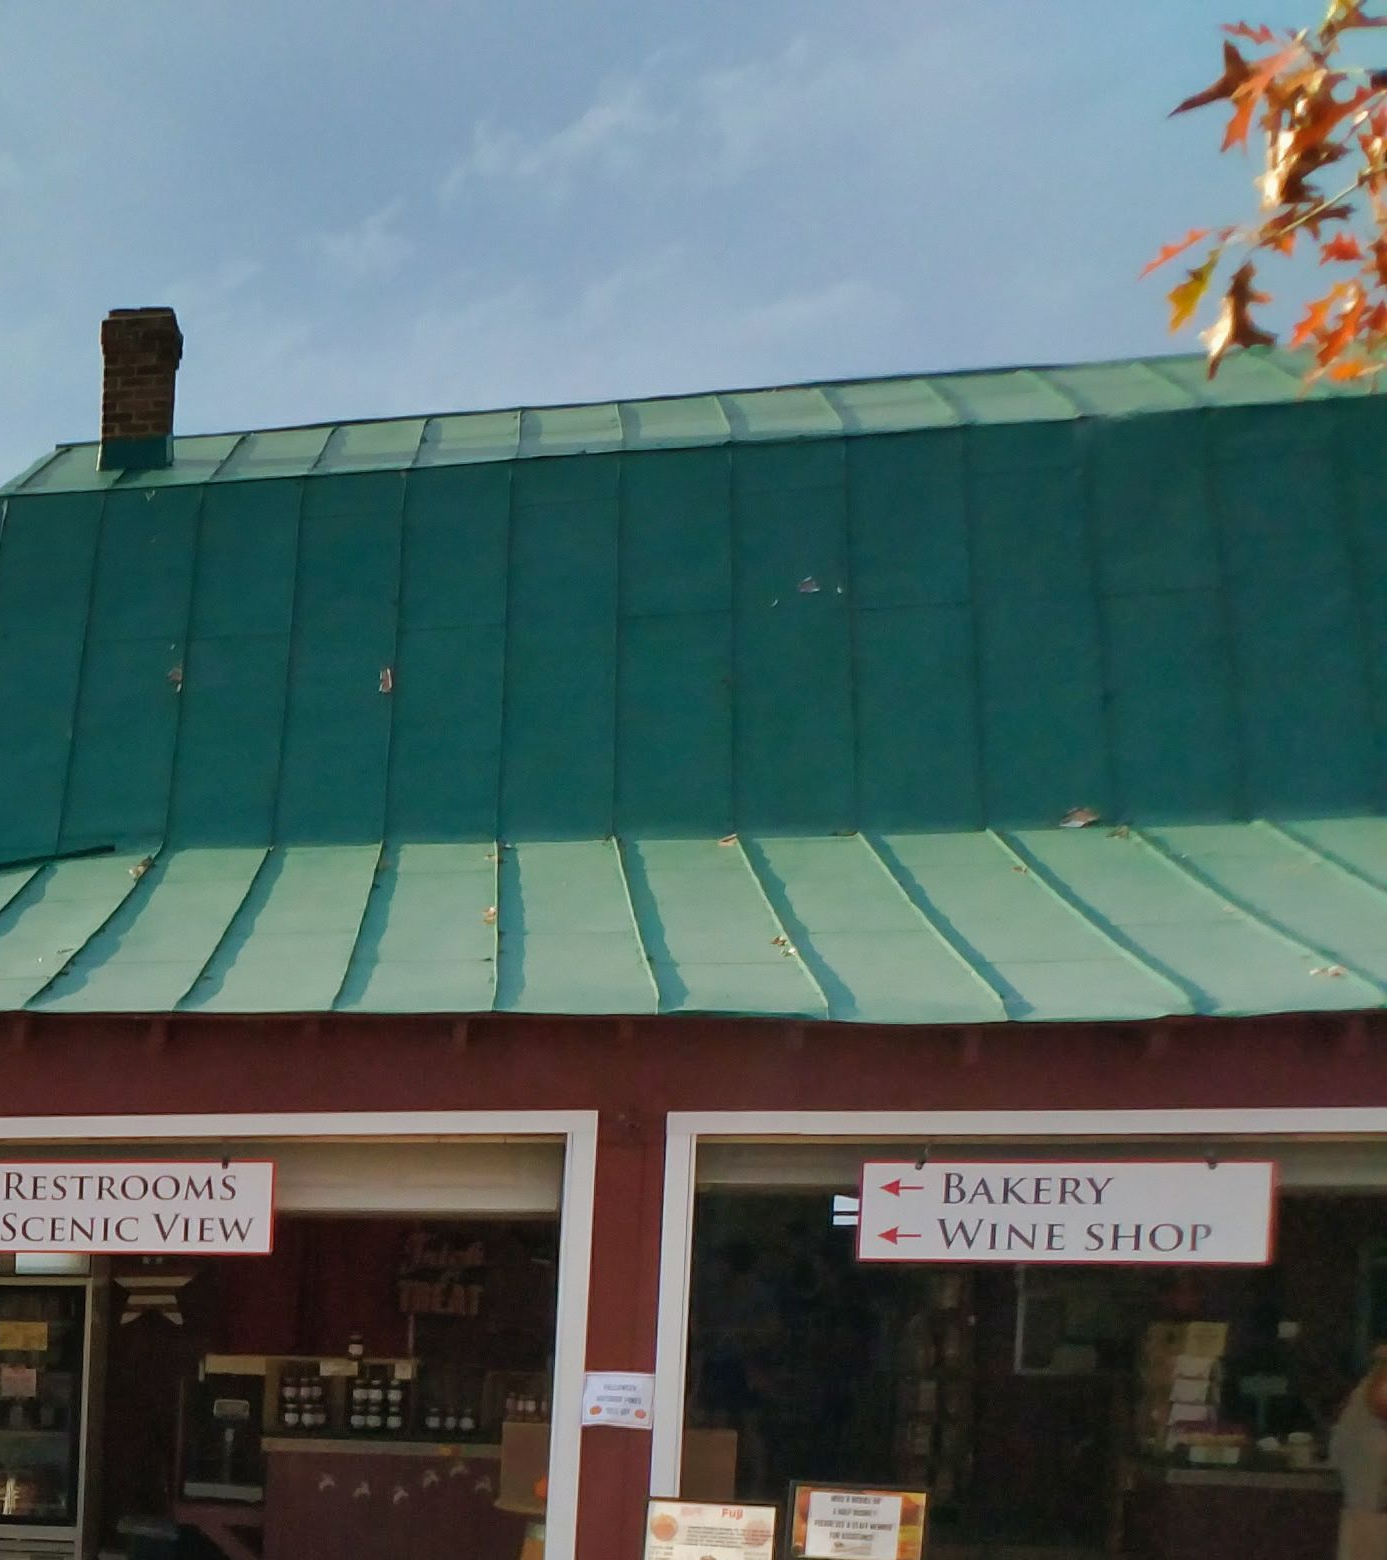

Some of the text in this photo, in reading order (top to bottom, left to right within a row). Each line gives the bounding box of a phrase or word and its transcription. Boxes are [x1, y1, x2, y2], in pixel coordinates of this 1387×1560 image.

[3, 1171, 237, 1201] RESTROOMS
[942, 1172, 1114, 1205] BAKERY
[0, 1213, 255, 1243] SCENIC VIEW
[937, 1218, 1212, 1252] WINE SHOP
[722, 1508, 743, 1520] Fuji
